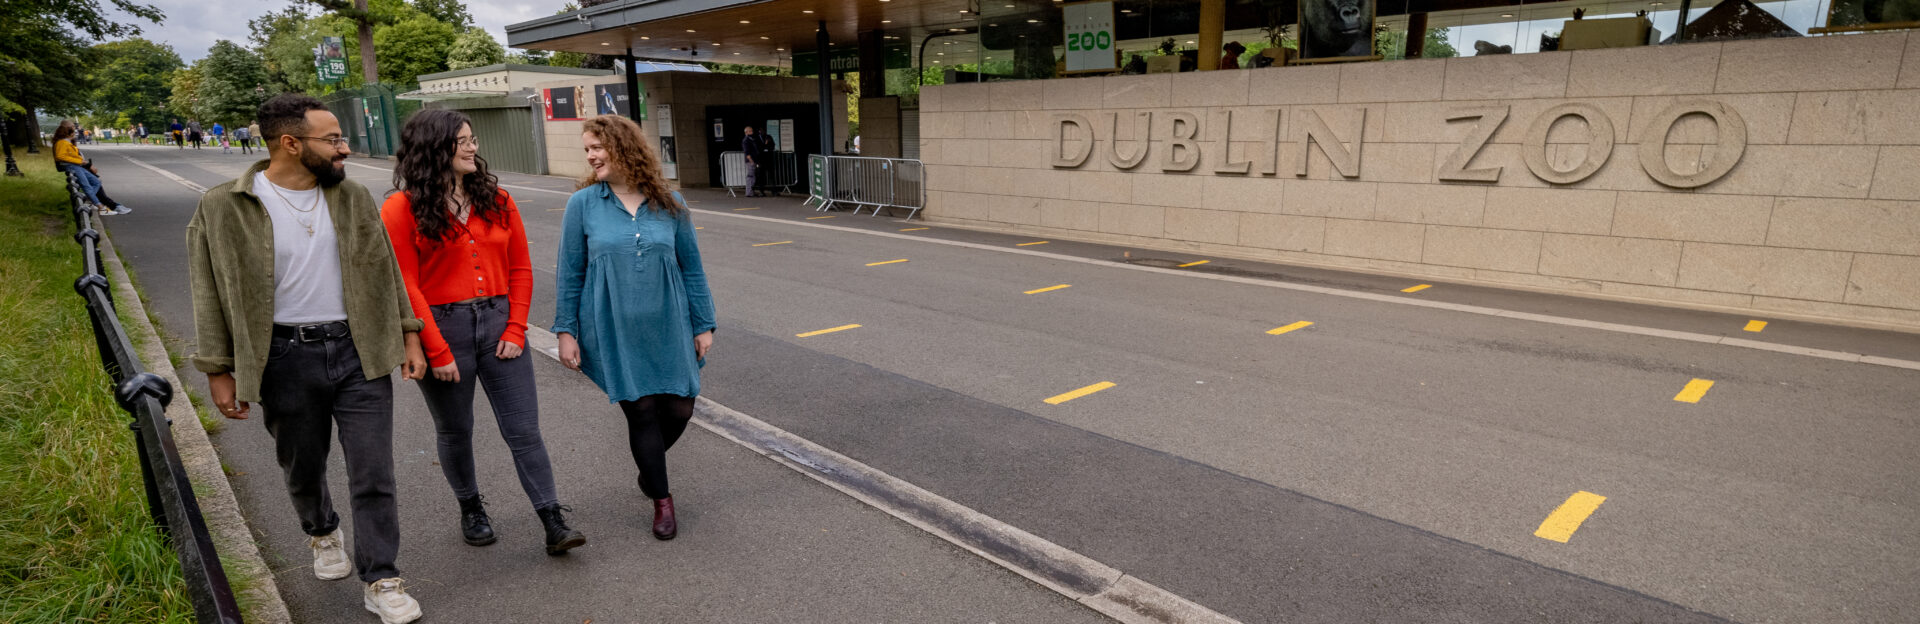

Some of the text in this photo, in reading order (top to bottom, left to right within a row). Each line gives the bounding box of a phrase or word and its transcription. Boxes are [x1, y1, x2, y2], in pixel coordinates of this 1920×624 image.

[1068, 30, 1111, 51] ZOO
[830, 56, 860, 70] ntran
[1051, 100, 1748, 189] DUBLIN ZOO
